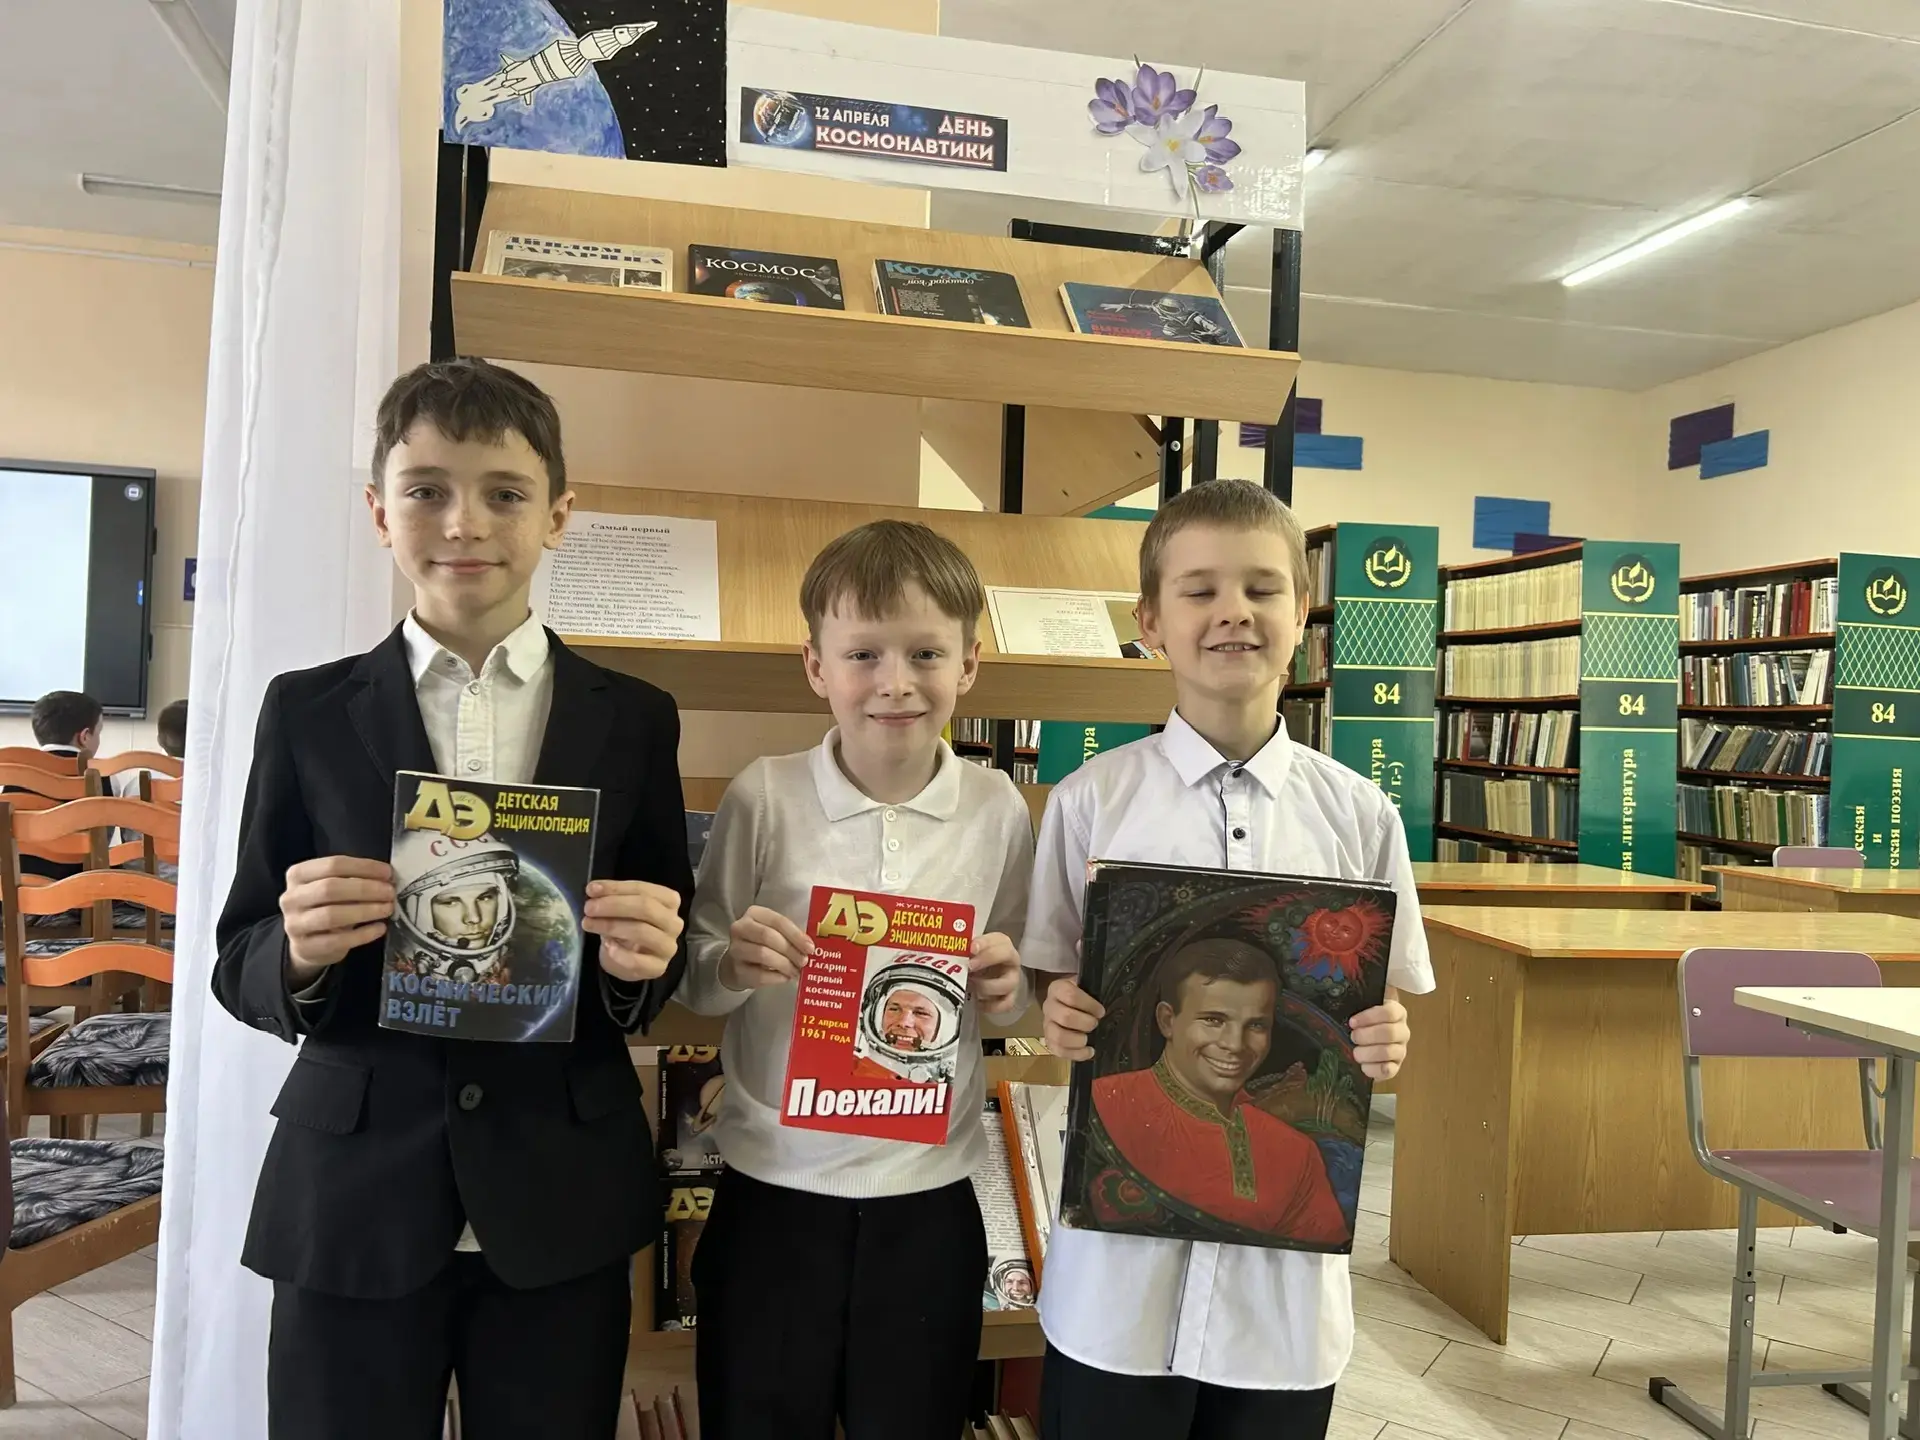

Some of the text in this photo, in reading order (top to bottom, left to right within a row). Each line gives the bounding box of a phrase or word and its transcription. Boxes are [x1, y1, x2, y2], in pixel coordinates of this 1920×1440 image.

[815, 106, 890, 128] 12 АПРЕЛЯ
[938, 114, 994, 137] ДЕНЬ
[816, 126, 994, 162] КОСМОНАВТИКИ
[705, 258, 816, 279] КОСМОС
[590, 523, 670, 534] Самый первый
[1374, 684, 1400, 705] 84
[1619, 694, 1645, 716] 84
[1871, 703, 1896, 723] 84
[496, 792, 559, 811] ДЕТСКАЯ
[1622, 748, 1636, 846] литература
[1891, 768, 1902, 824] поэзия
[404, 780, 492, 841] ДЭ
[494, 813, 590, 835] ЭНЦИКЛОПЕДИЯ
[1873, 834, 1882, 843] и
[896, 902, 944, 912] ЖУРНАЛ
[816, 892, 889, 946] ДЭ
[892, 910, 944, 929] ДЕТСКАЯ
[890, 929, 968, 952] ЭНЦИКЛОПЕДИЯ
[808, 958, 847, 973] Гагарин
[894, 954, 962, 975] СССР
[388, 972, 567, 1006] КОСМИЧЕСКИЙ
[808, 974, 842, 984] первый
[806, 986, 856, 998] космонавт
[387, 998, 461, 1028] ВЗЛЁТ
[804, 998, 842, 1009] планеты
[802, 1014, 849, 1029] 12 апреля
[801, 1028, 851, 1043] 1961 года
[787, 1078, 946, 1117] Поехали!
[665, 1187, 714, 1223] ДЭ
